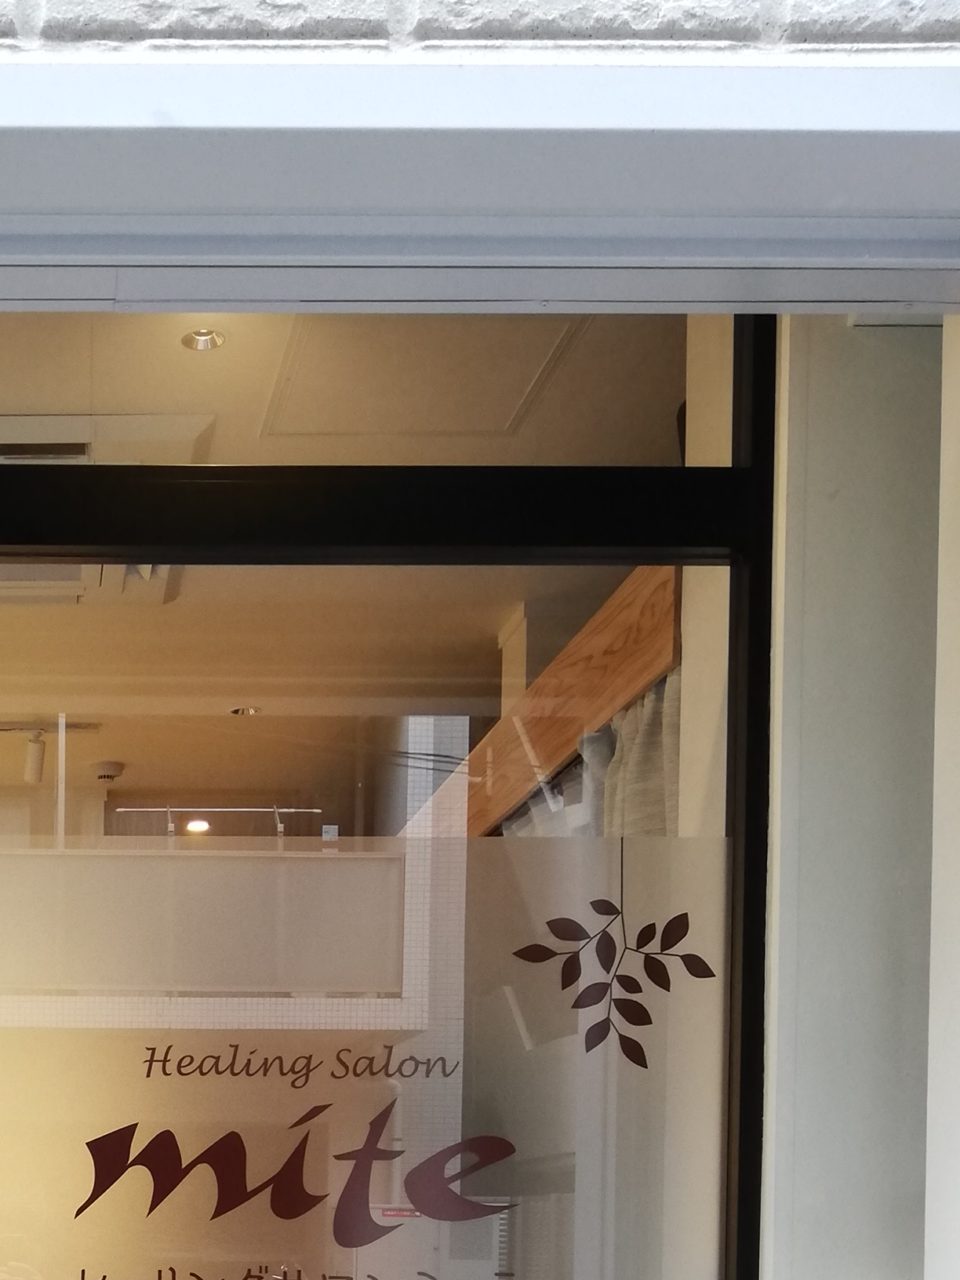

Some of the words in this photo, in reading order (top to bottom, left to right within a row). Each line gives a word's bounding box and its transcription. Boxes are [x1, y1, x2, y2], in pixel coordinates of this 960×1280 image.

[143, 1044, 323, 1089] Healing
[329, 1044, 459, 1081] Salon
[73, 1097, 520, 1249] mite
